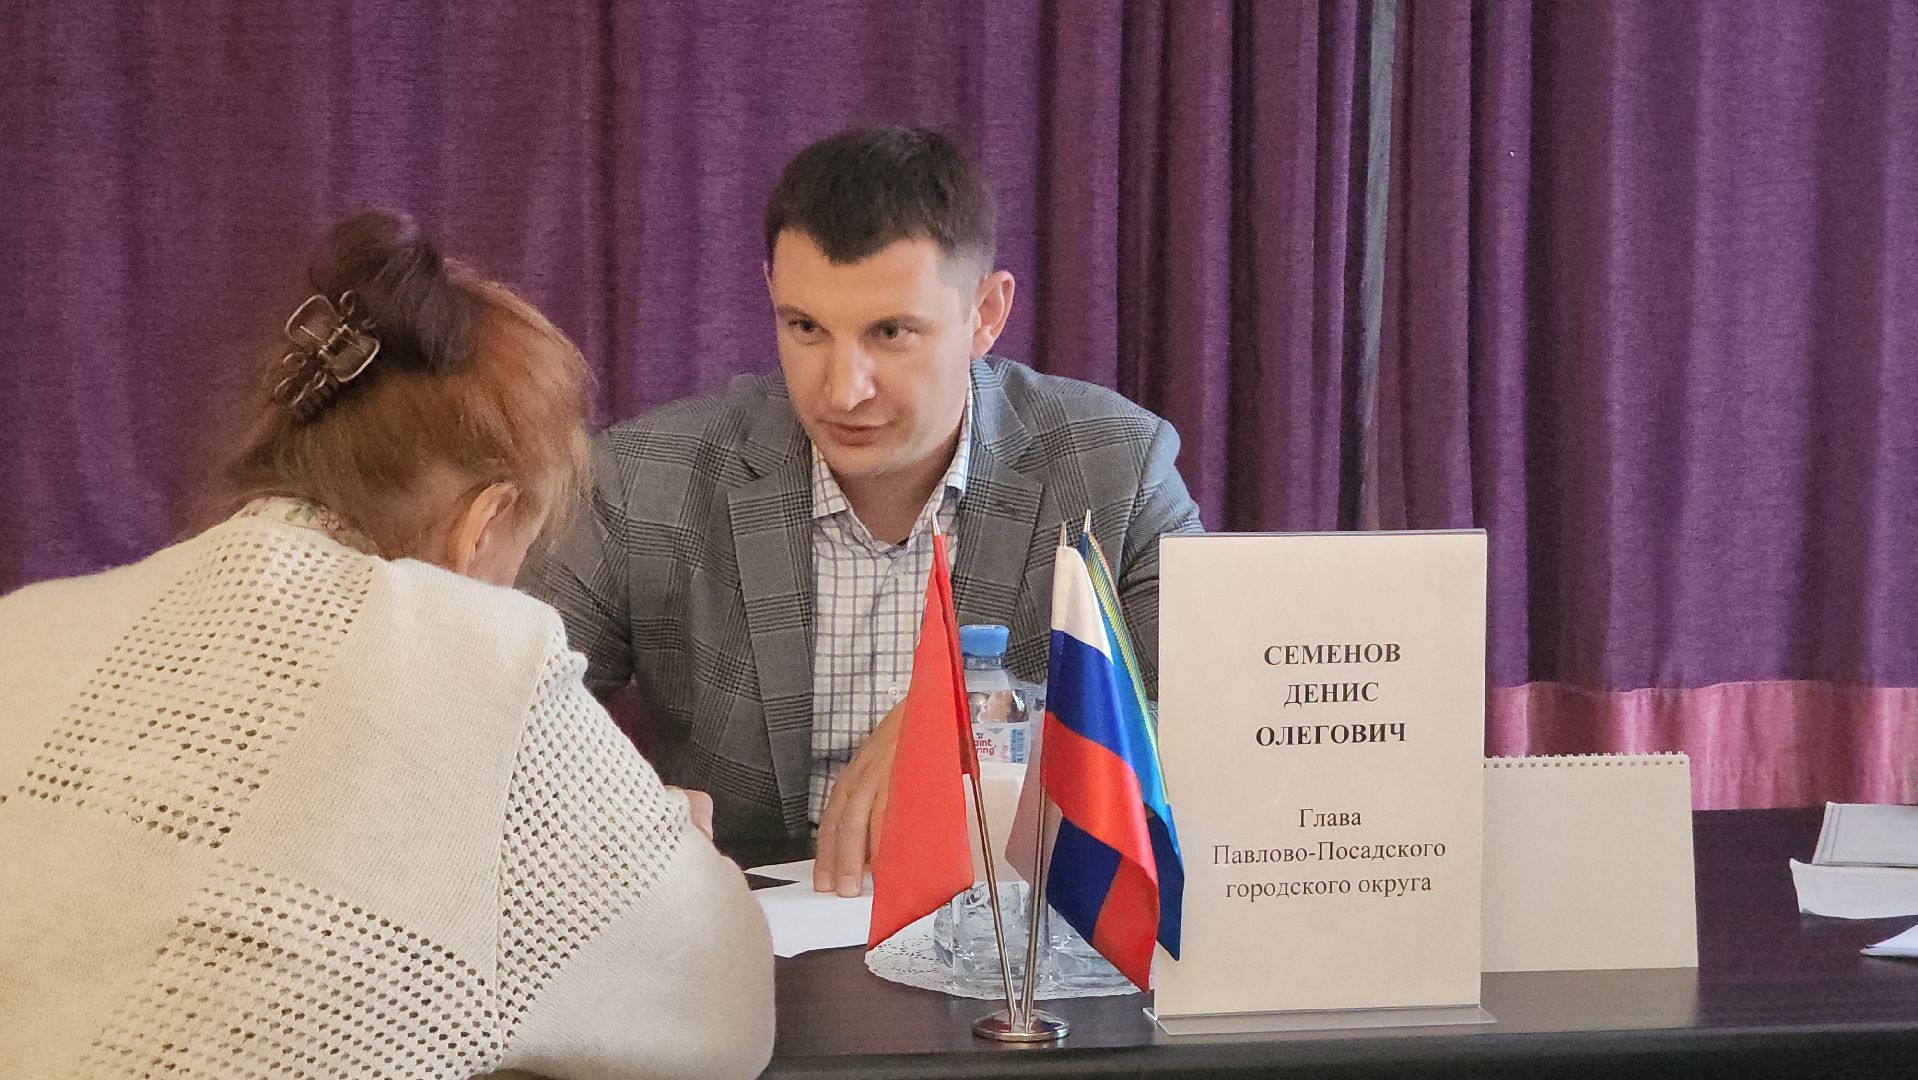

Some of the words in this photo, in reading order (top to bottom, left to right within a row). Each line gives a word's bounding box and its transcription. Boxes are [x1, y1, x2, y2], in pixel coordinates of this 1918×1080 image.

[1263, 643, 1401, 666] СЕМЕНОВ
[1283, 681, 1380, 709] ДЕНИС
[1255, 722, 1407, 747] ОЛЕГОВИЧ
[1298, 808, 1362, 828] Глава
[1213, 841, 1446, 865] Павлово-Посадского
[1225, 878, 1351, 902] городского
[1358, 876, 1432, 897] округа
